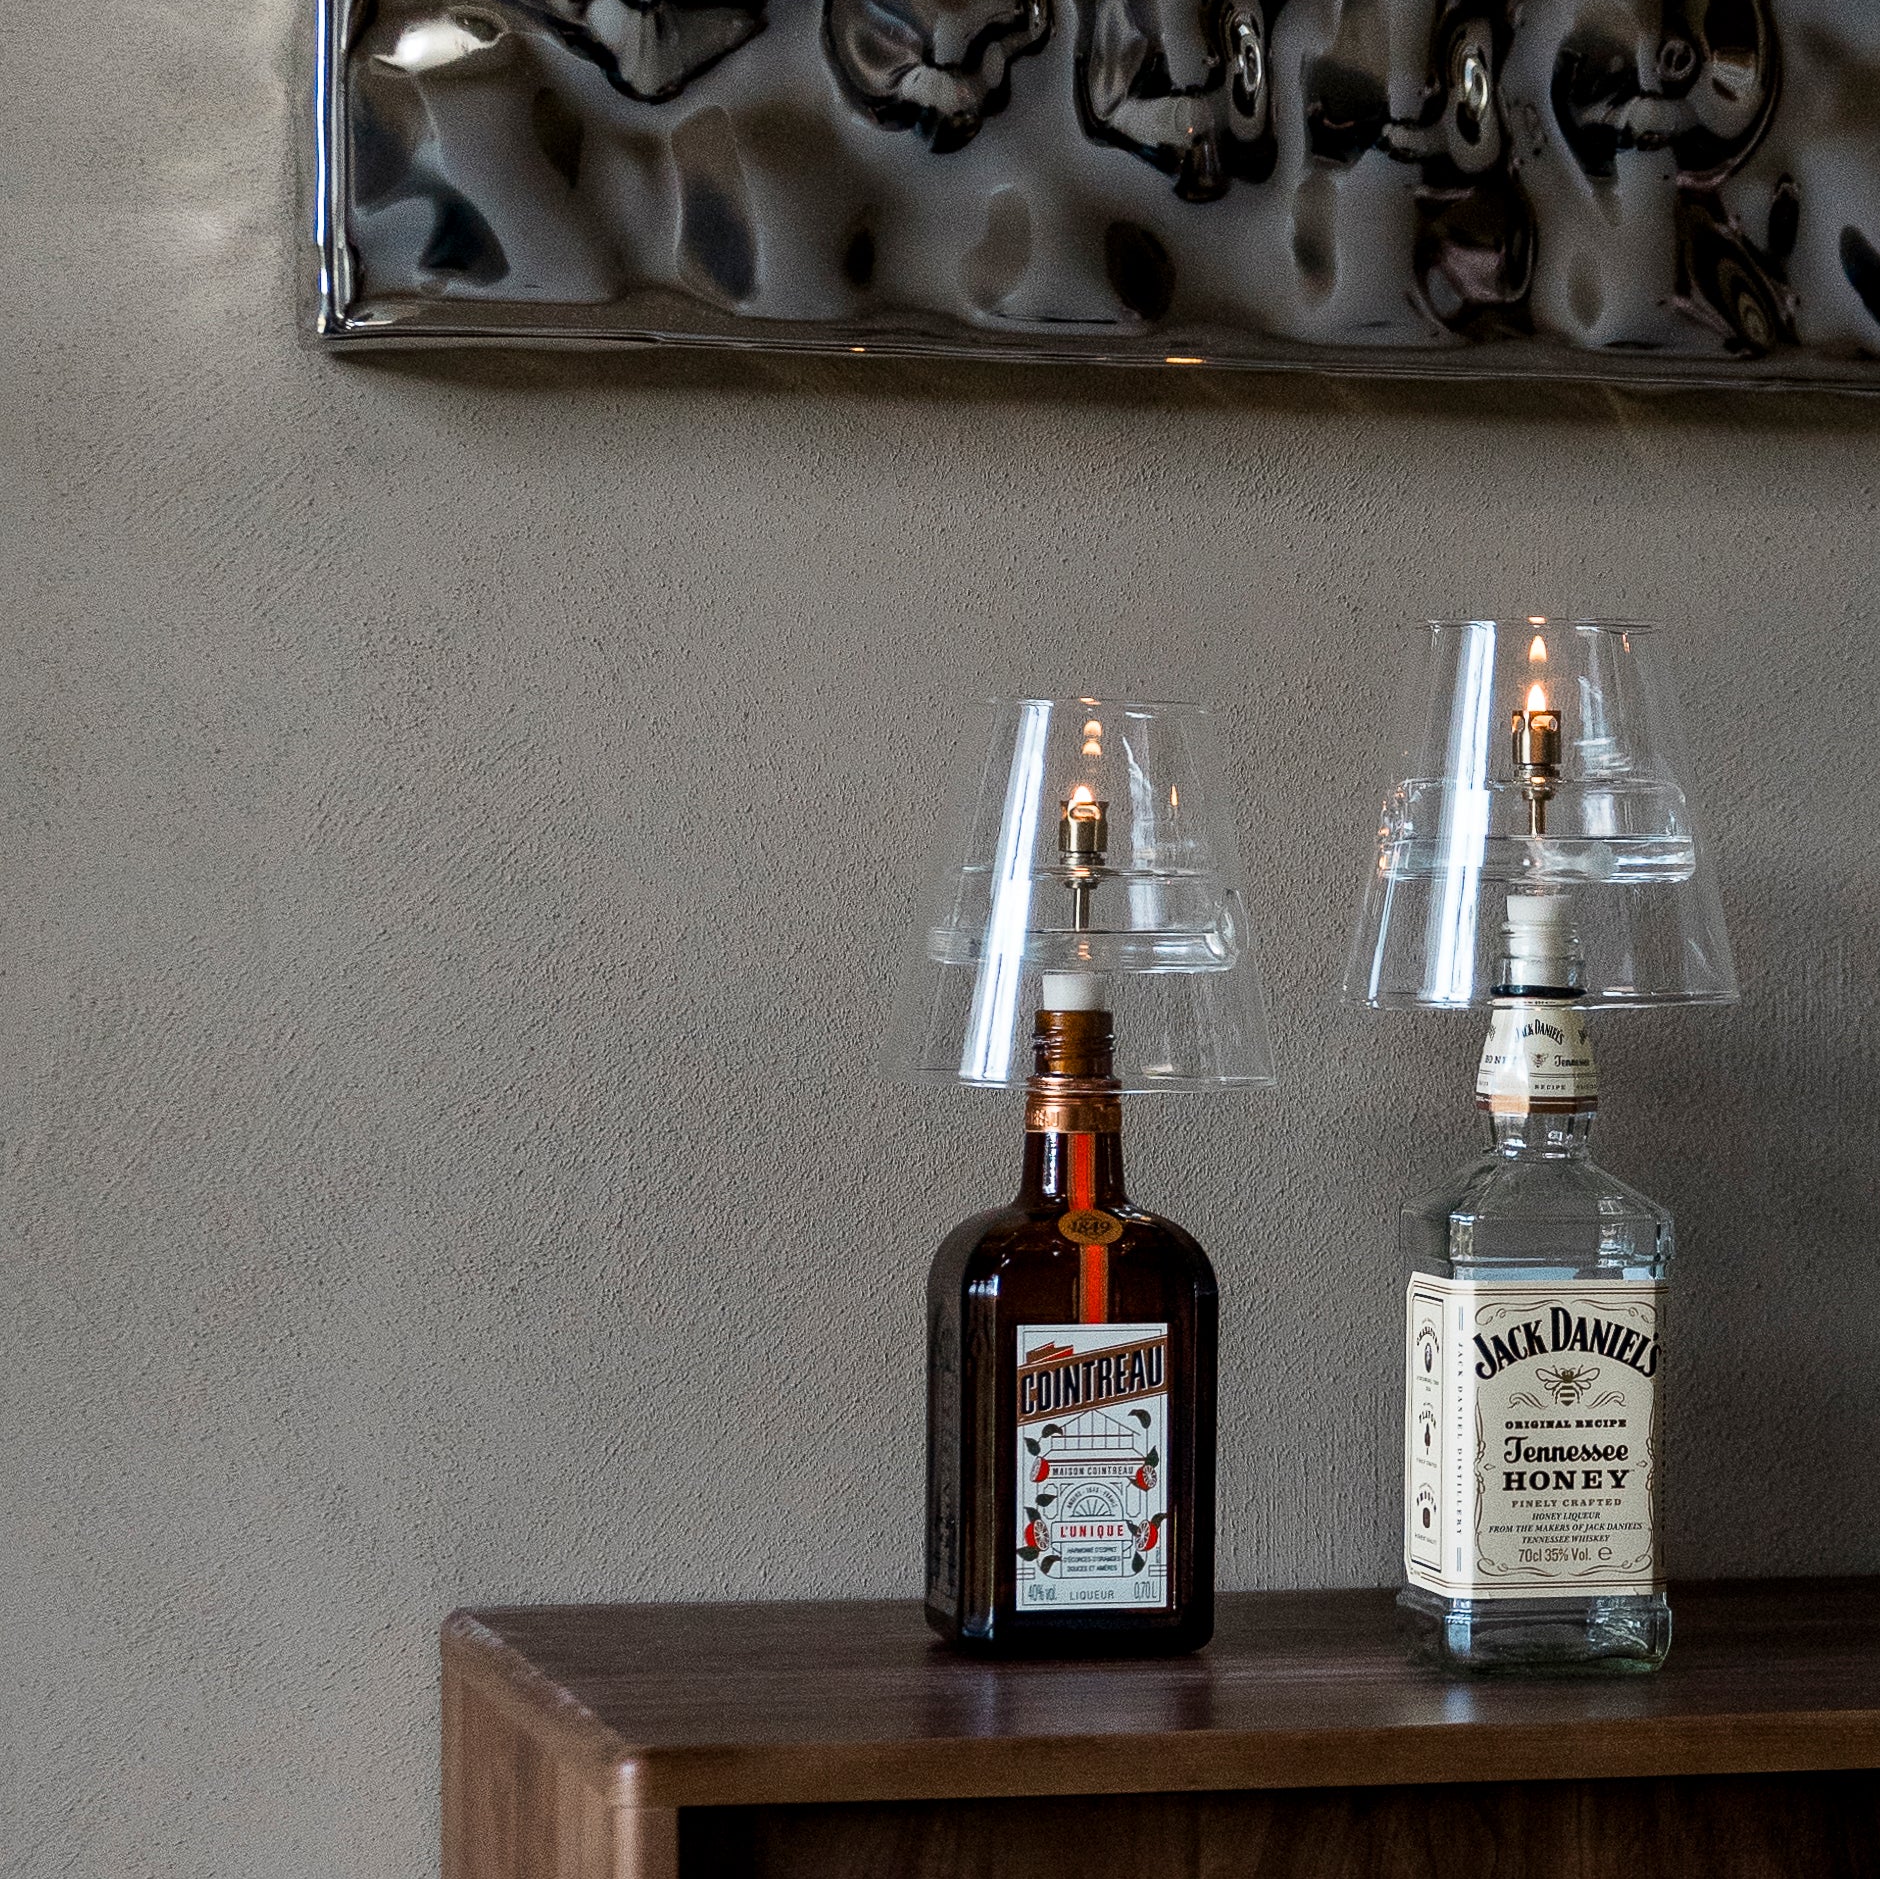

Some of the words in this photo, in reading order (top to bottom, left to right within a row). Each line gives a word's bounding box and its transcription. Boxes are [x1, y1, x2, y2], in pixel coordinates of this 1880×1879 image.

[1472, 1319, 1549, 1381] JACK
[1549, 1307, 1662, 1378] DANIEL'S
[1021, 1345, 1165, 1417] COINTREAU
[1505, 1420, 1572, 1430] ORIGINAL
[1575, 1419, 1627, 1428] RECIPE
[1504, 1436, 1629, 1464] Tennessee
[1052, 1467, 1085, 1476] MAISON
[1087, 1466, 1134, 1475] COINTREAU
[1502, 1470, 1630, 1491] HONEY
[1512, 1500, 1557, 1508] FINELY
[1562, 1499, 1622, 1507] CRAFTED
[1563, 1512, 1601, 1521] LIQUEUR
[1060, 1525, 1124, 1538] L'UNIQUE
[1488, 1525, 1513, 1533] FROM
[1535, 1524, 1570, 1532] MAKERS
[1583, 1524, 1605, 1533] JACK
[1522, 1536, 1570, 1544] TENNESSEE
[1571, 1534, 1611, 1542] WHISKEY
[1518, 1548, 1542, 1562] 70cl
[1544, 1548, 1568, 1562] 35%
[1571, 1548, 1592, 1561] Vol.
[1069, 1590, 1114, 1600] LIQUEUR
